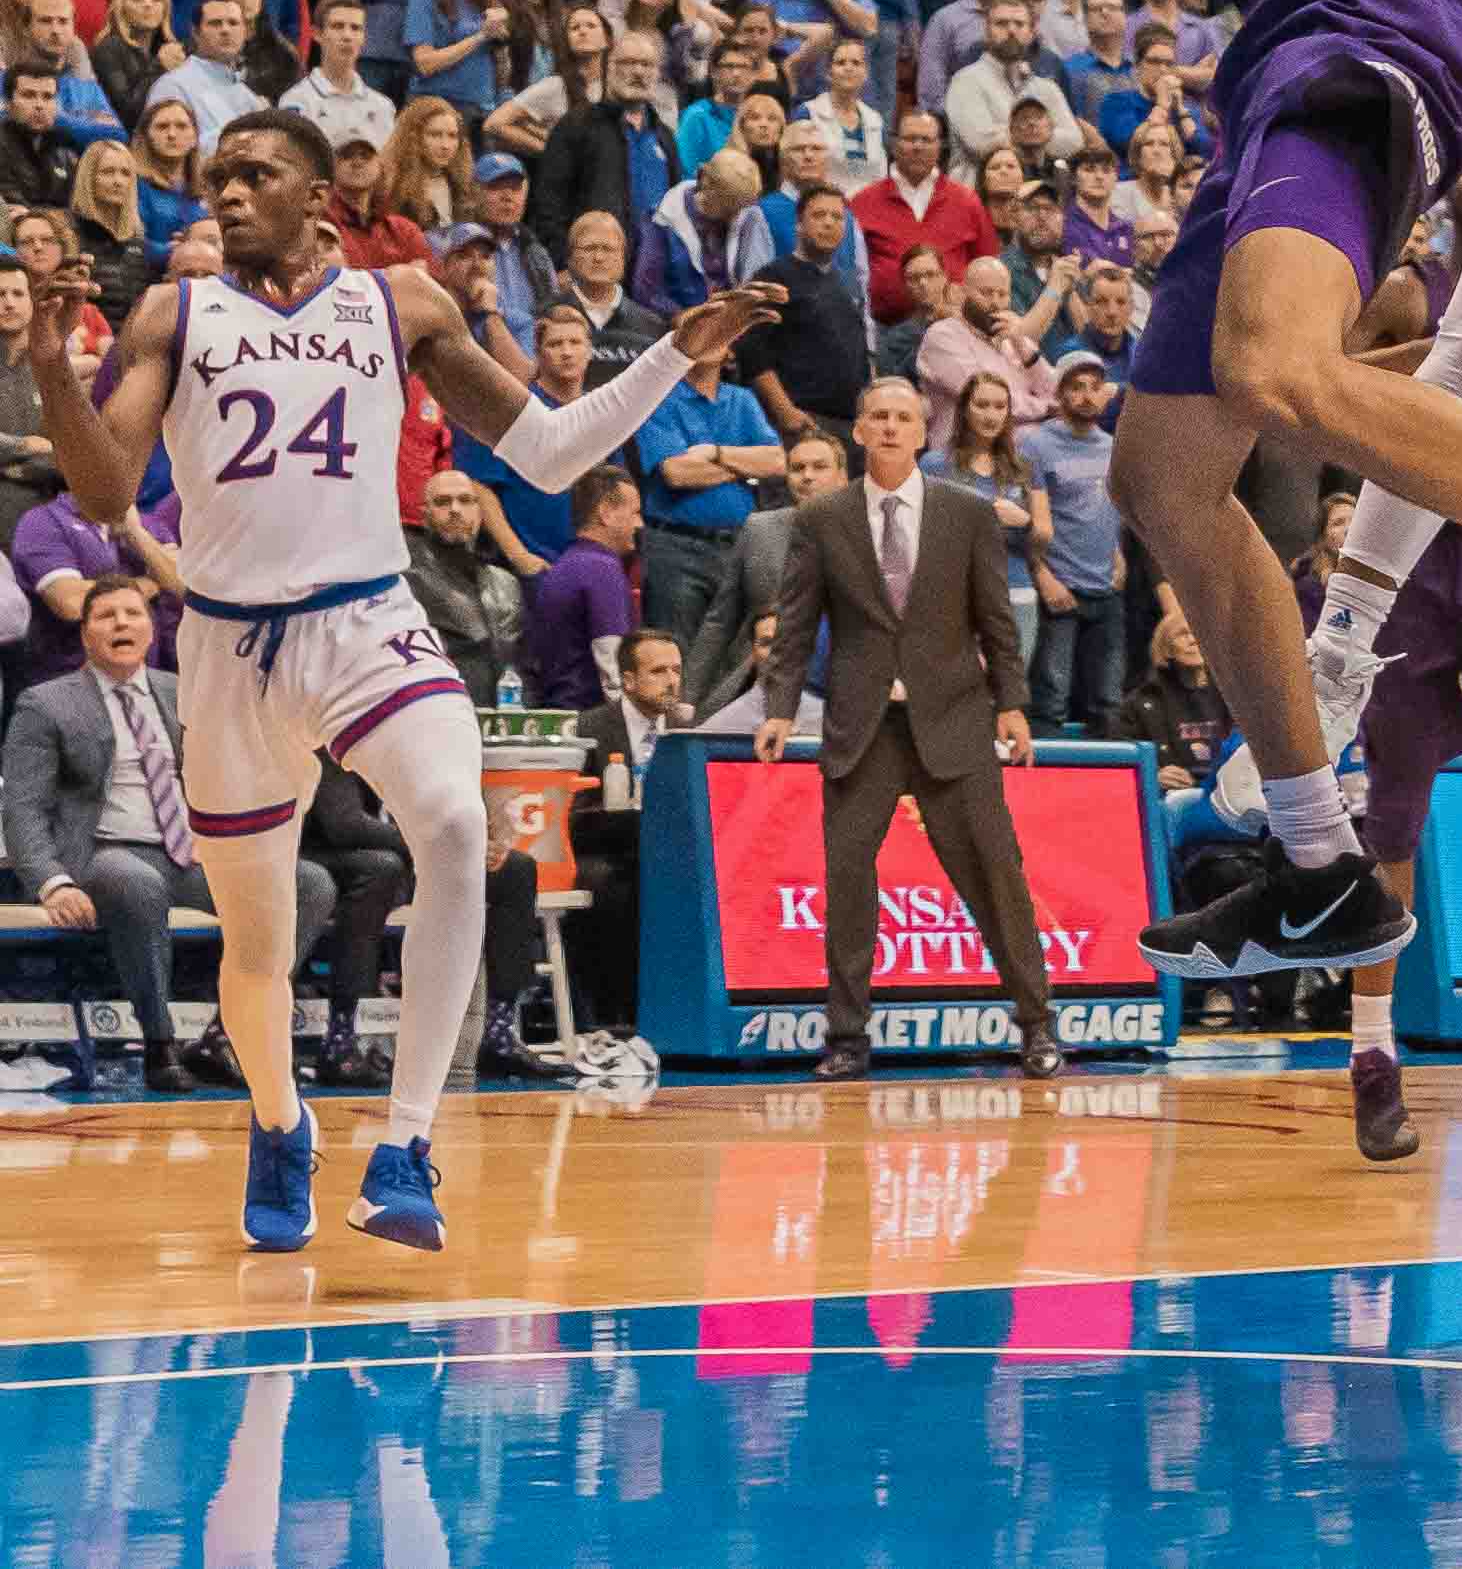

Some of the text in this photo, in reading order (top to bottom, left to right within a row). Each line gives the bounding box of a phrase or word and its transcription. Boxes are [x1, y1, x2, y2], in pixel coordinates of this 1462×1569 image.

[191, 332, 384, 388] KANSAS
[215, 386, 358, 484] 24
[766, 1003, 1165, 1051] ROKET MOGAGE
